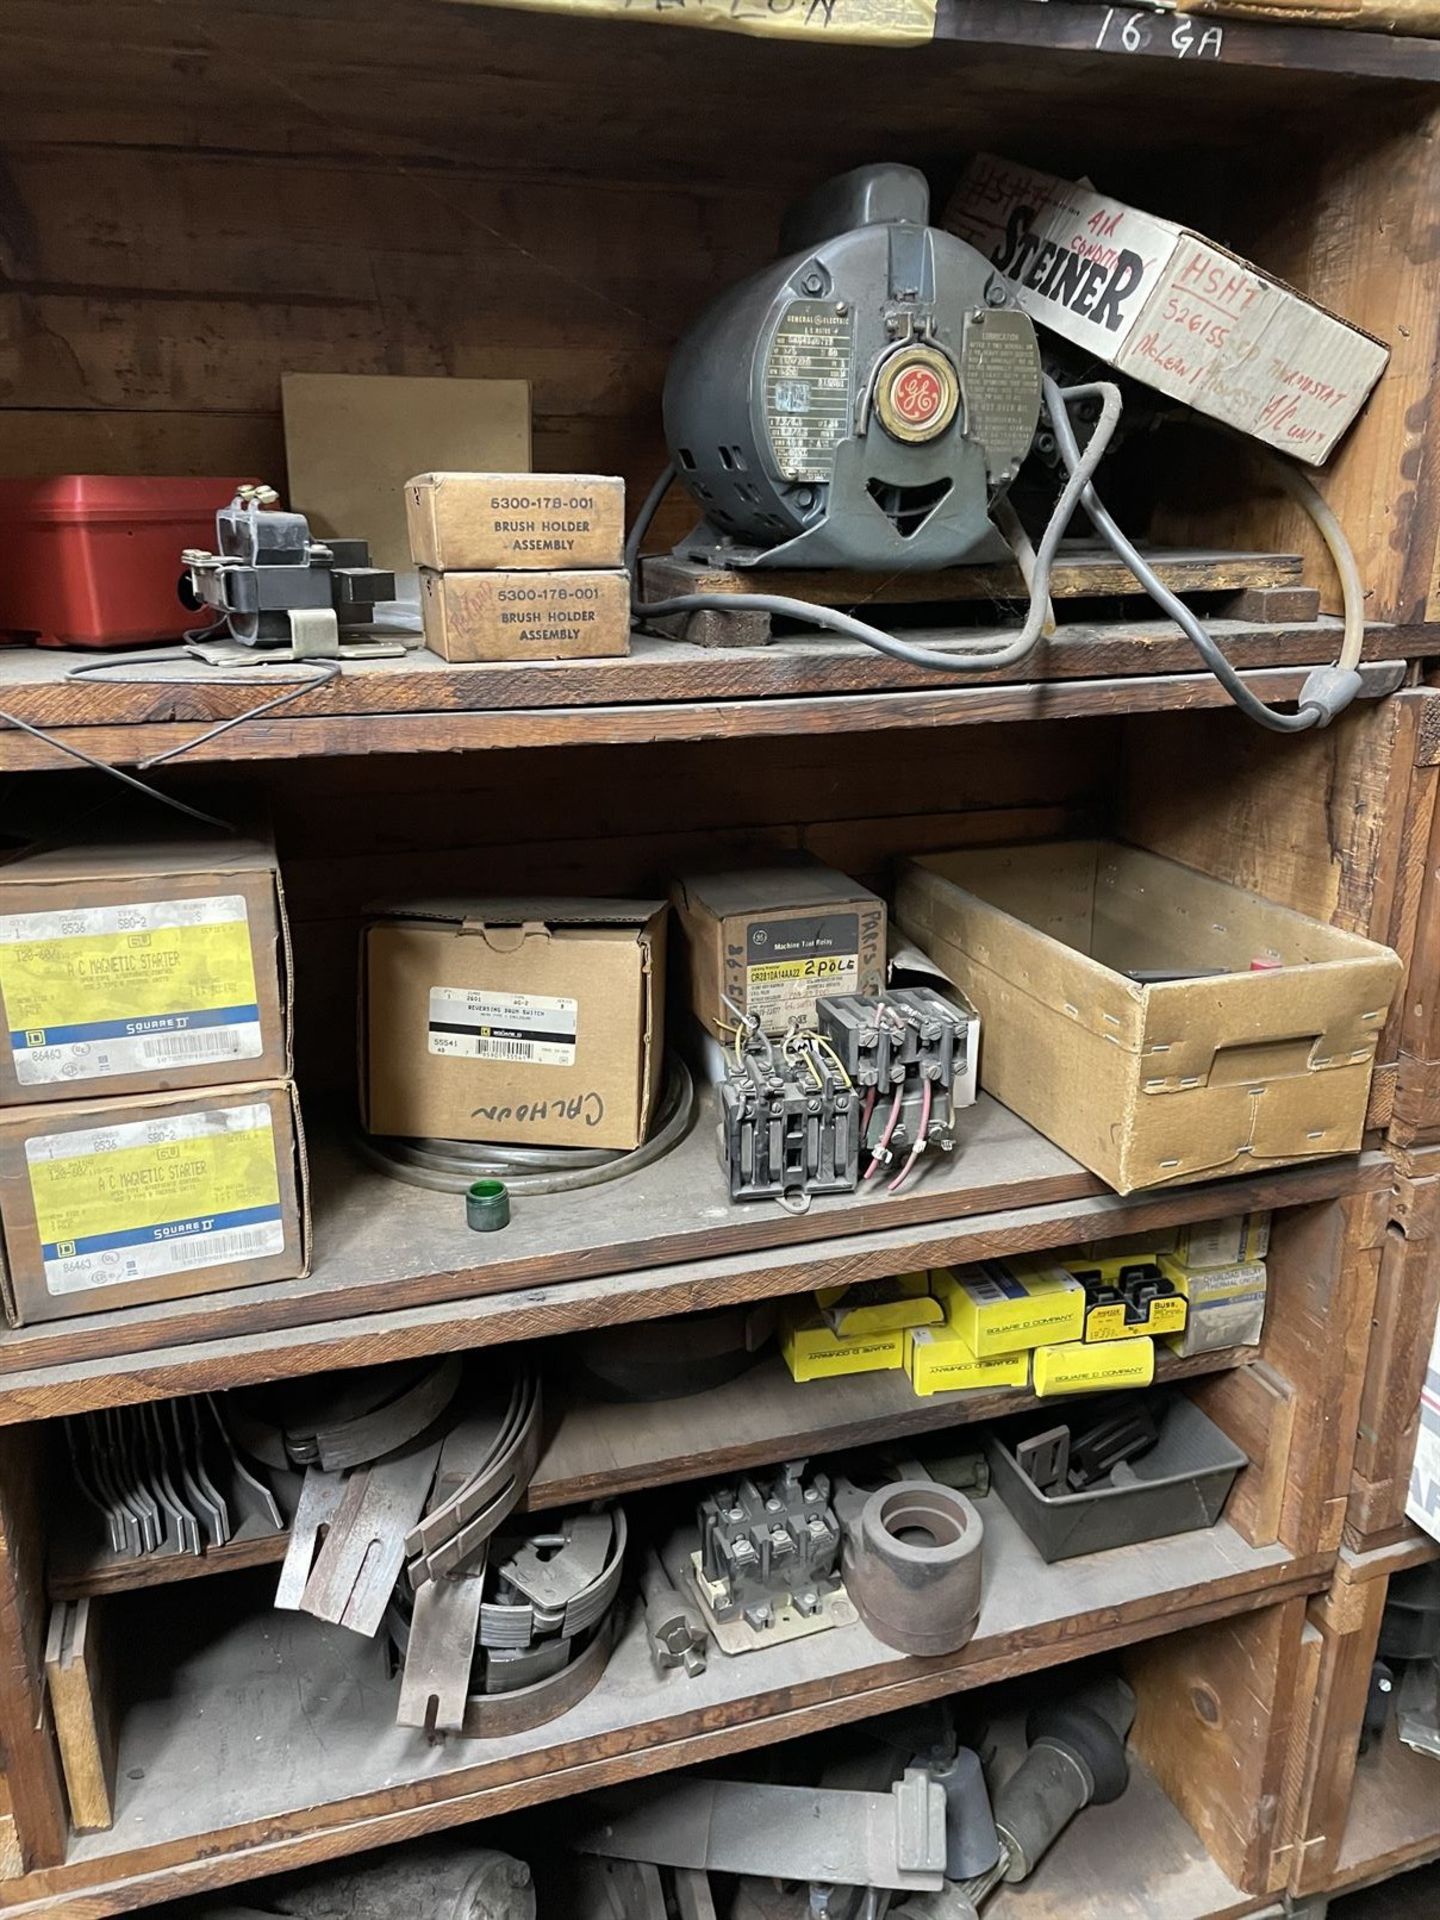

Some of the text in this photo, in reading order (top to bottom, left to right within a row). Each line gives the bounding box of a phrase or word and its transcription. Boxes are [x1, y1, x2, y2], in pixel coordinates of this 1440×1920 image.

[1096, 8, 1222, 58] 16 GA
[1087, 209, 1124, 238] AIR
[990, 205, 1144, 332] STEINER
[1162, 298, 1231, 349] 526155
[490, 497, 594, 510] 5300-178-001
[494, 521, 590, 532] BRUSH HOLDER
[512, 539, 575, 550] ASSEMBLY
[498, 588, 599, 601] 5300-178-001
[501, 611, 595, 624] BRUSH HOLDER
[519, 629, 580, 641] ASSEMBLY
[774, 941, 800, 950] Machine
[816, 938, 833, 947] Relay
[79, 960, 86, 975] C
[90, 953, 137, 975] MAGNETIC
[140, 950, 181, 970] STARTER
[804, 960, 855, 976] 2 POLE
[522, 1009, 545, 1017] SWITCH
[126, 1021, 174, 1035] SQUARE
[471, 1092, 604, 1126] CALHOUN
[109, 1175, 116, 1189] C
[120, 1167, 165, 1188] MAGNETIC
[168, 1160, 207, 1179] STARTER
[153, 1222, 199, 1240] SQUARE
[987, 1324, 1020, 1335] SQUARE
[1032, 1313, 1074, 1326] COMPANY
[862, 1343, 895, 1353] SQUARE
[1055, 1373, 1089, 1382] SQUARE
[1101, 1367, 1143, 1378] COMPANY
